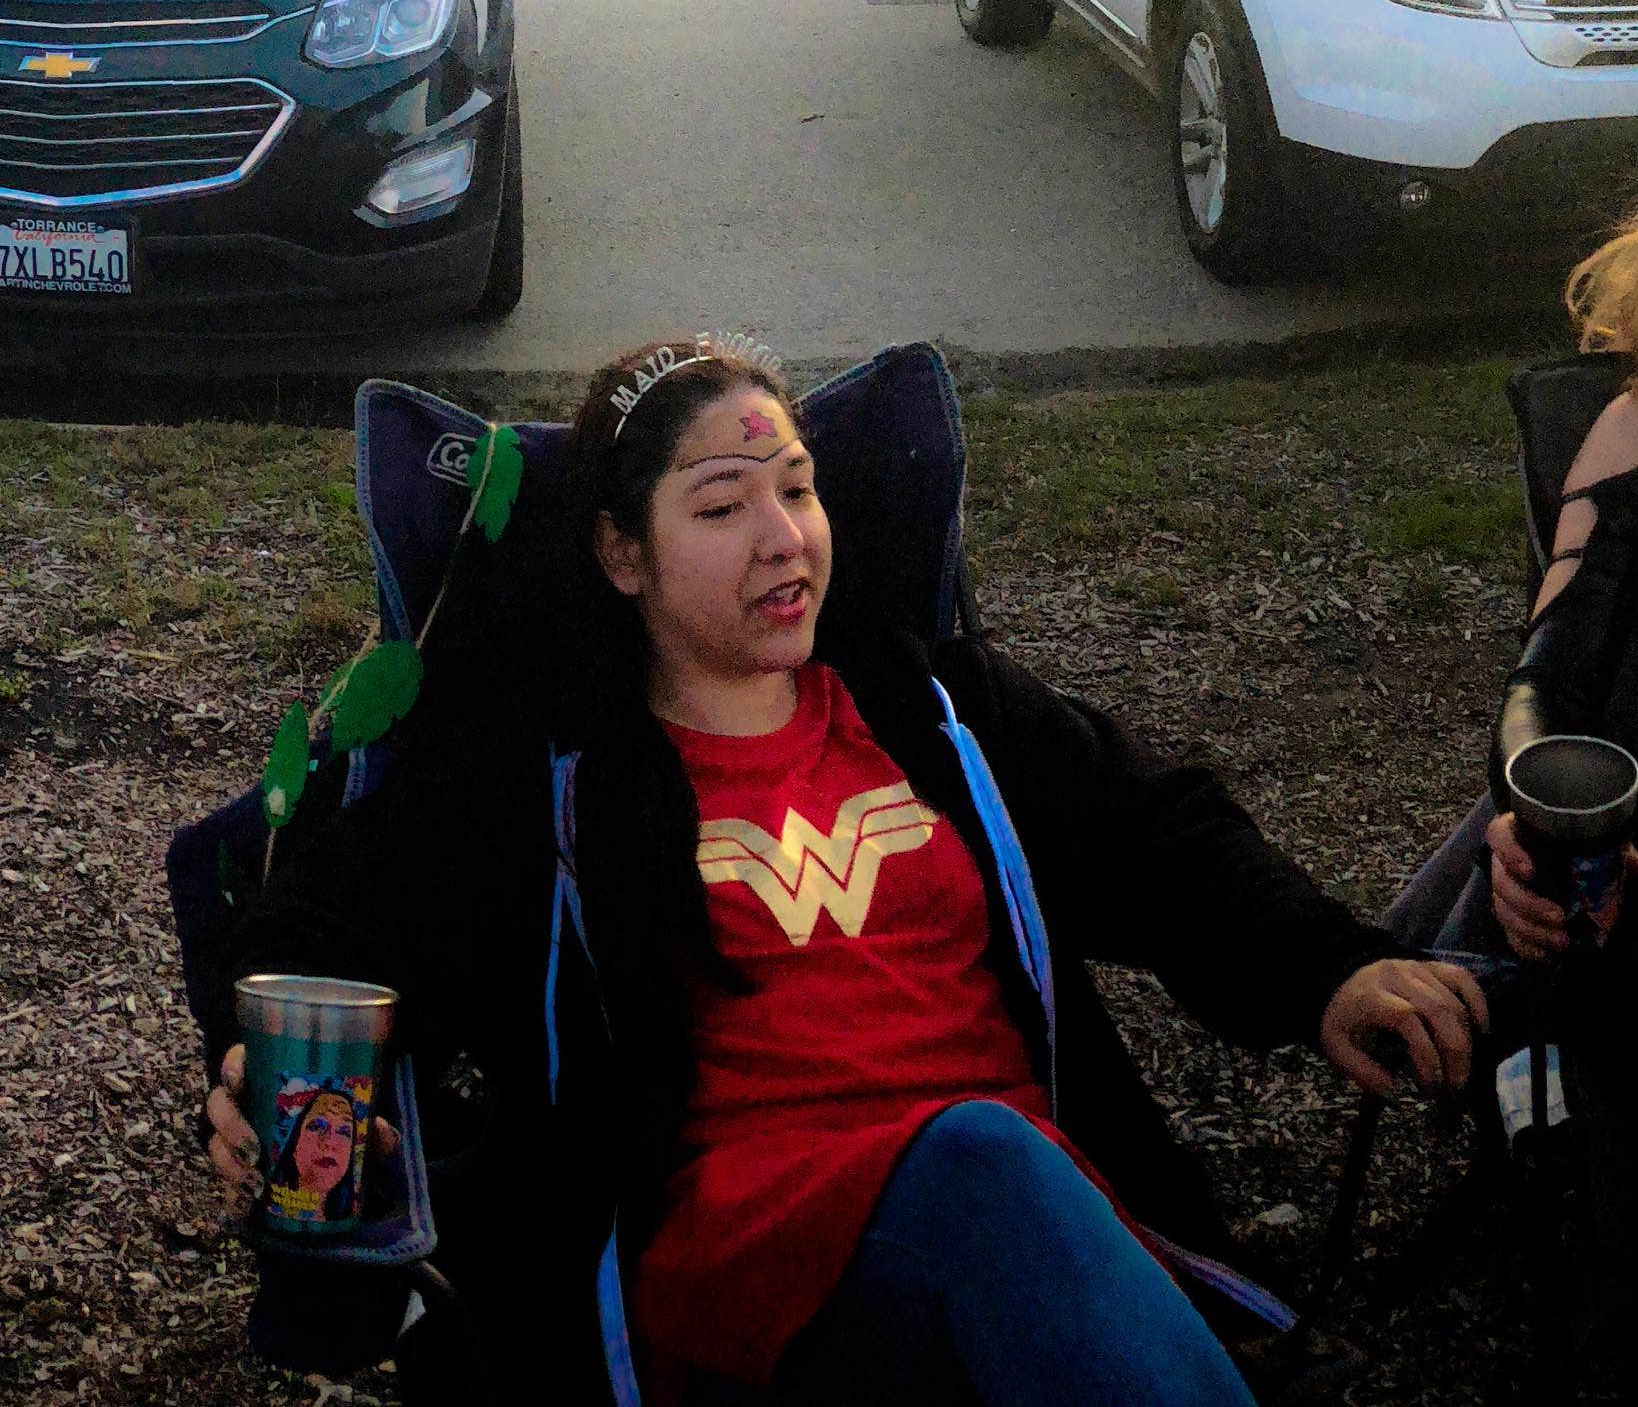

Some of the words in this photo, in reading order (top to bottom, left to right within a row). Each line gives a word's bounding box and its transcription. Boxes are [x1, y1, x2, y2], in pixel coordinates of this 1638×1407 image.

[17, 218, 97, 233] TORRANCE
[0, 246, 124, 283] 7XLB540
[609, 345, 677, 415] MAID
